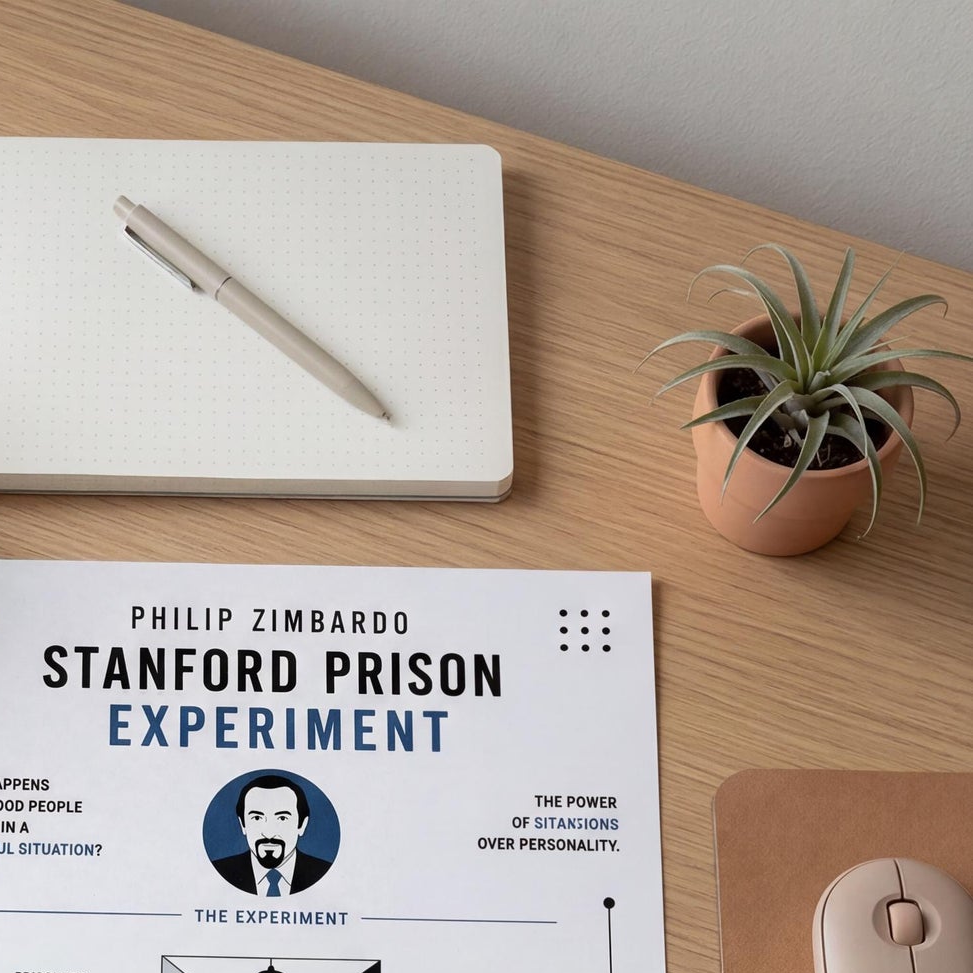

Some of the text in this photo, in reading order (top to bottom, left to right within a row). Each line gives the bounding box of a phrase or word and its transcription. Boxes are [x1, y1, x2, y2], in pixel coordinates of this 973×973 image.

[132, 606, 408, 634] PHILIP ZIMBARDO
[42, 646, 501, 697] STANFORD PRISON
[110, 704, 448, 752] EXPERIMENT
[29, 800, 82, 813] PEOPLE
[535, 795, 617, 808] THE POWER
[1, 821, 16, 833] IN
[20, 822, 29, 833] A
[512, 817, 530, 828] OF
[19, 843, 103, 856] SITUATION?
[478, 837, 620, 851] OVER PERSONALITY.
[195, 910, 348, 925] THE EXPERIMENT
